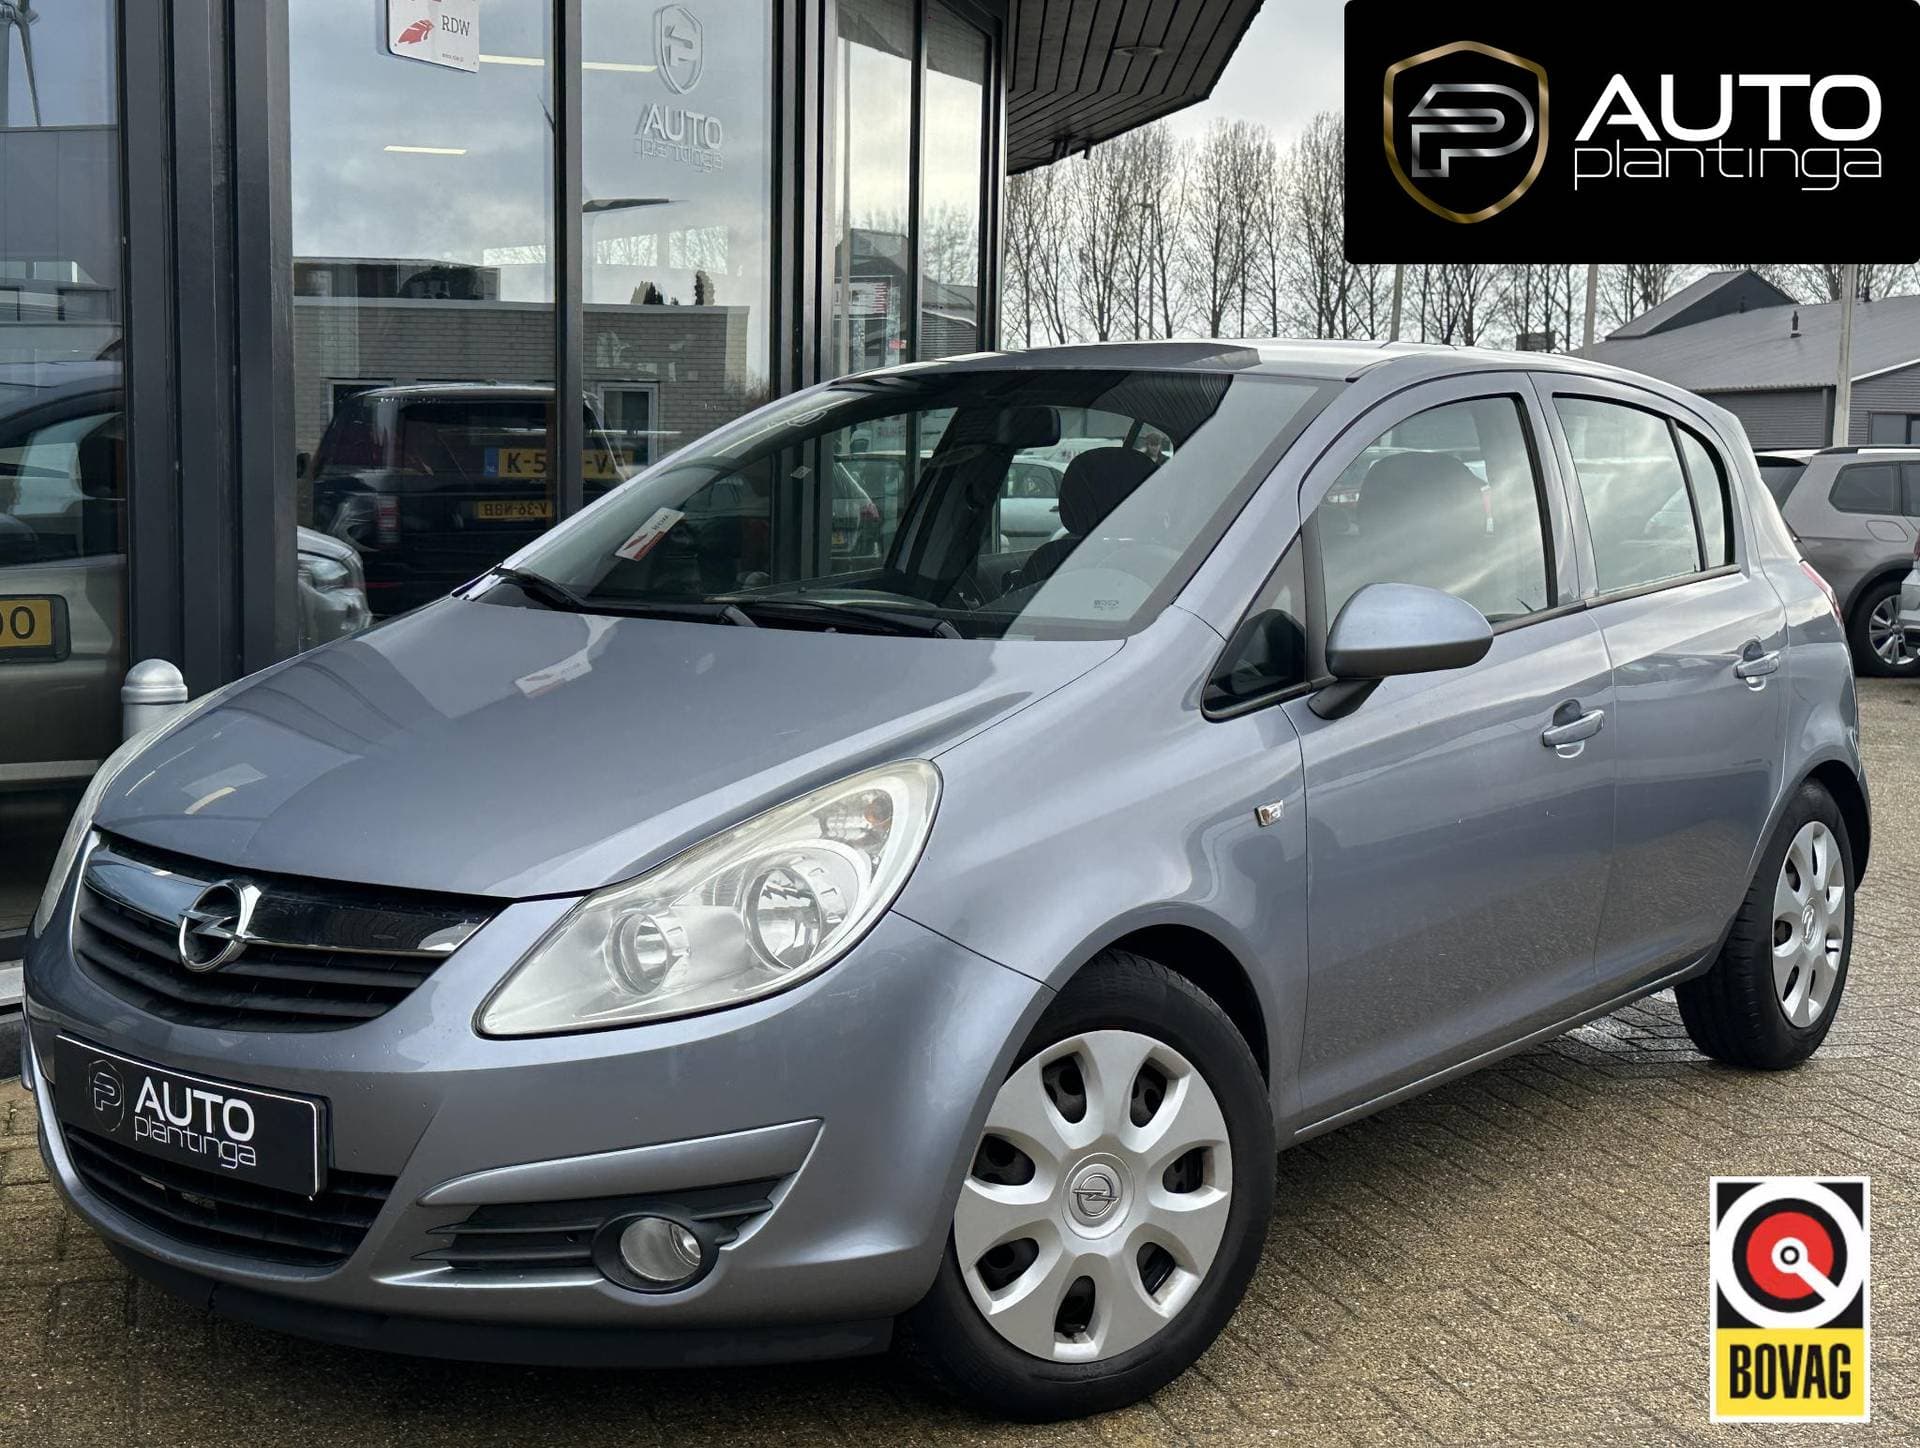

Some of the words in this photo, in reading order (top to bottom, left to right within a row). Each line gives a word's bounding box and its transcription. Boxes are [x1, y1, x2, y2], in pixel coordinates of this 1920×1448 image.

[441, 15, 470, 37] RDW
[643, 102, 723, 150] AUTO
[134, 1075, 255, 1142] AUTO
[134, 1115, 257, 1169] plantinga
